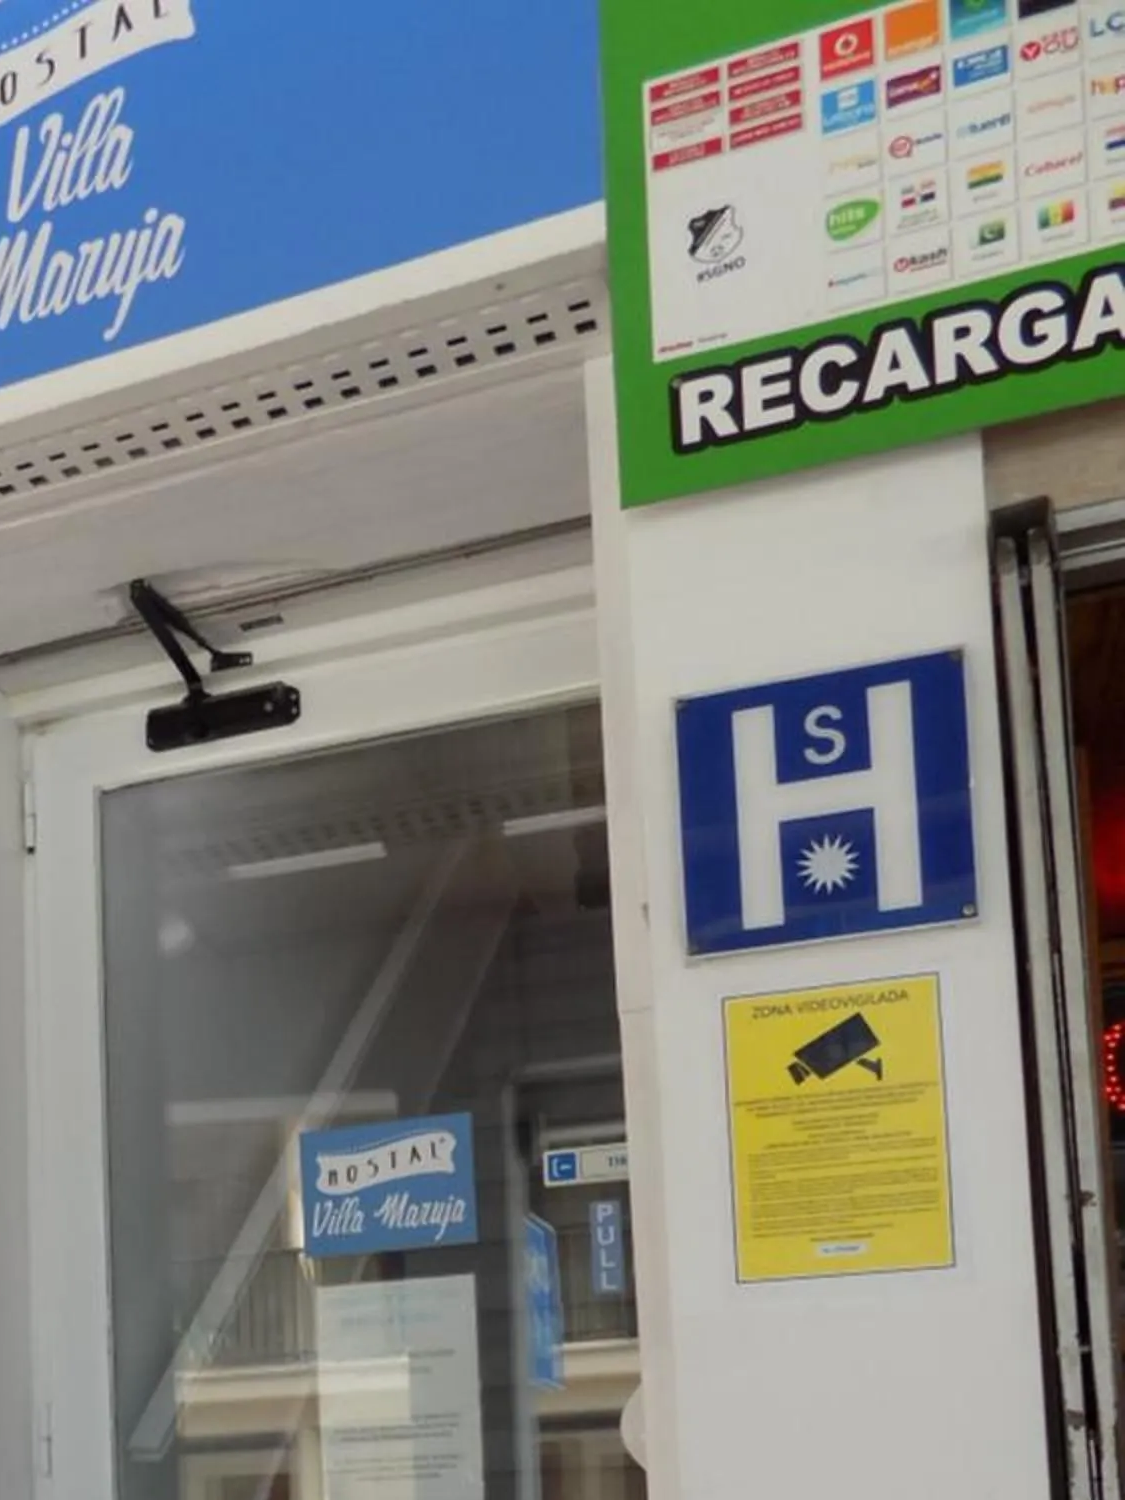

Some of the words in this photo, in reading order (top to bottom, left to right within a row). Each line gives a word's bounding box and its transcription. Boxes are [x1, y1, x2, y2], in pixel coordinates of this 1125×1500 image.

[6, 86, 135, 223] Villa
[677, 268, 1125, 448] RECARGA
[802, 705, 847, 766] S
[731, 680, 923, 931] H
[751, 1004, 794, 1020] ZONA
[797, 988, 909, 1014] VIDEOVIGILADA
[327, 1140, 442, 1187] HOSTAL
[312, 1195, 366, 1239] Villa
[373, 1191, 467, 1242] Maruja
[595, 1204, 618, 1291] PULL
